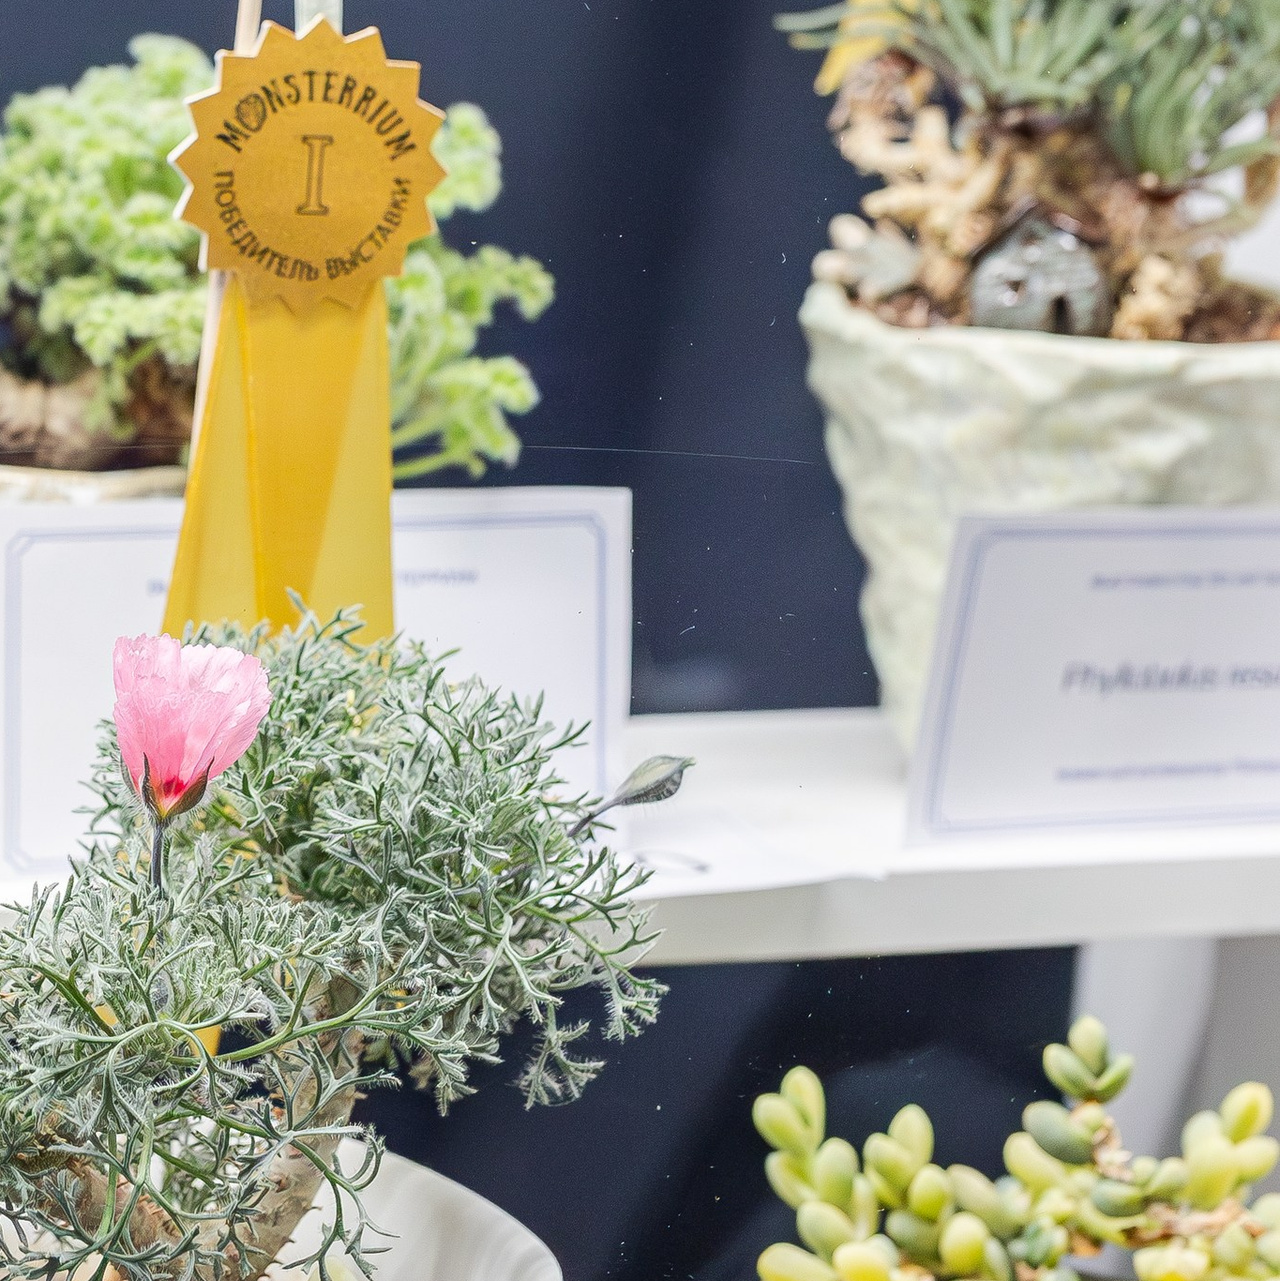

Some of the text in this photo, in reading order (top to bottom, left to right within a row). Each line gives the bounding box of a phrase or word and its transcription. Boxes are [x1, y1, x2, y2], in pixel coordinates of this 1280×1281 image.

[214, 70, 416, 161] MONSTERRIUM
[296, 134, 335, 216] I
[214, 171, 411, 281] ПОБЕДИТЕЛЬ ВЫСТАВКИ
